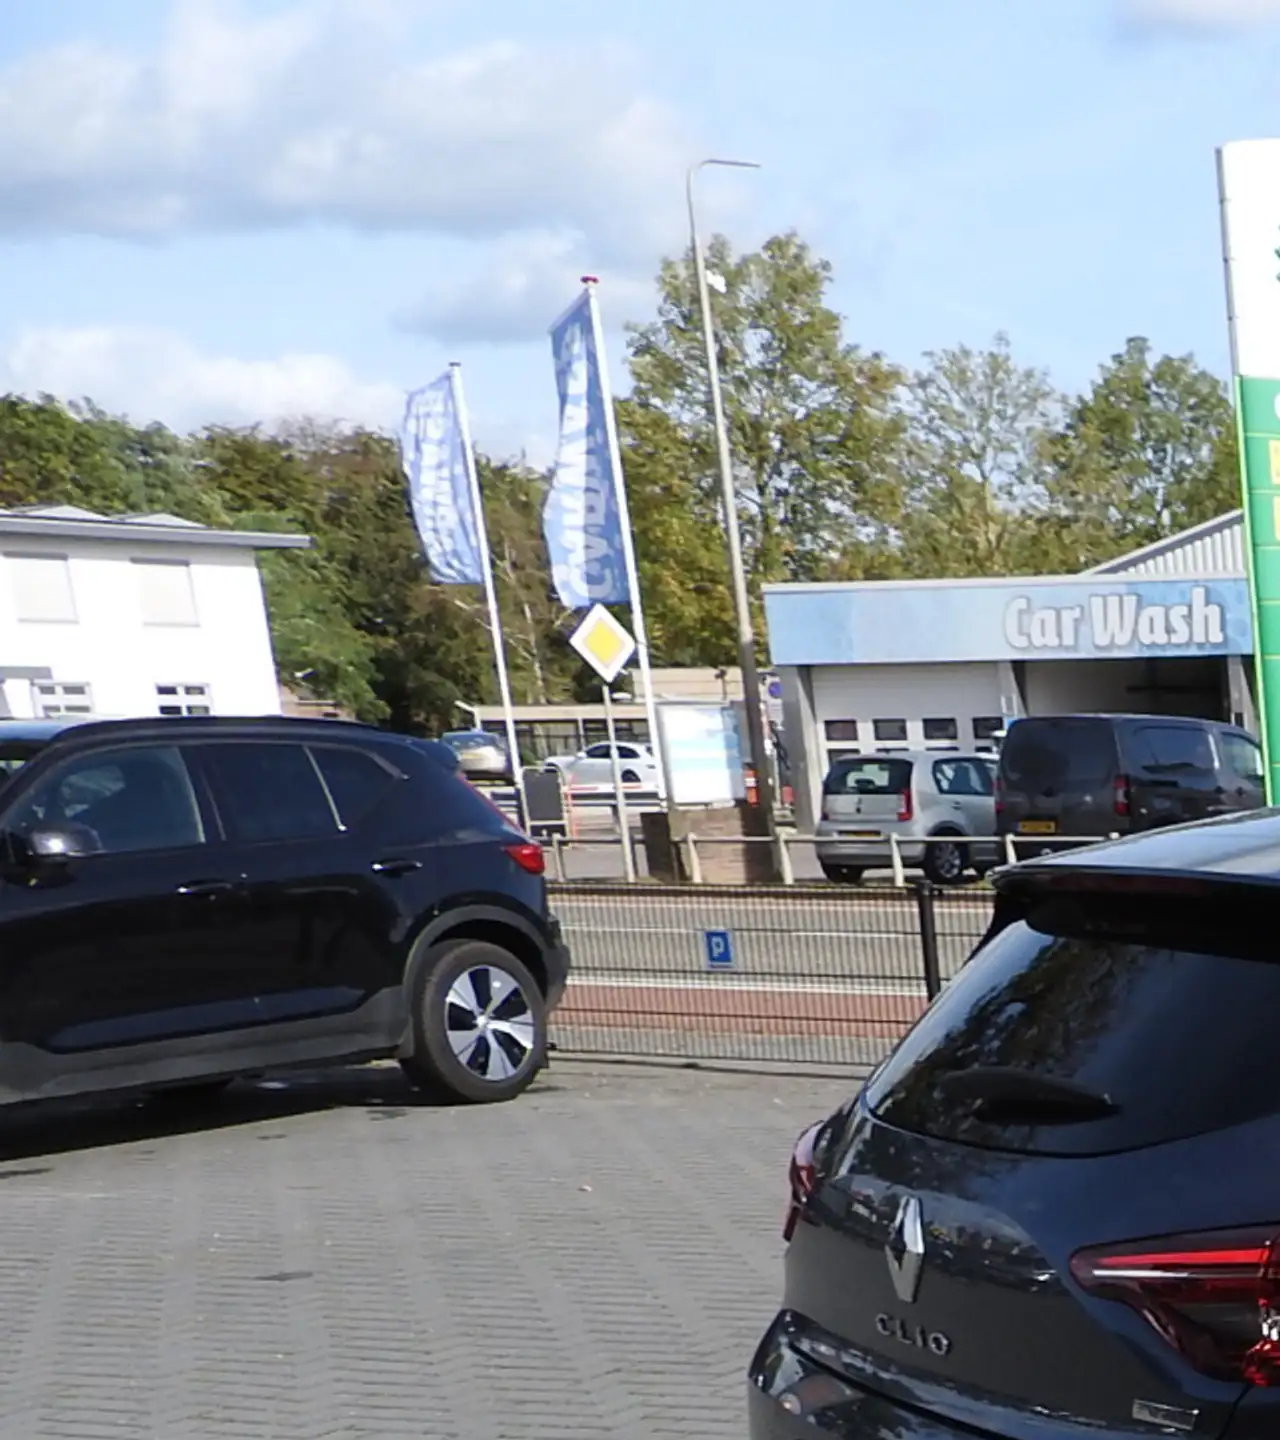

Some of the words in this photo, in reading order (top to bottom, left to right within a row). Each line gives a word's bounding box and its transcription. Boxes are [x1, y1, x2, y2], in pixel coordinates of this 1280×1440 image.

[1004, 595, 1083, 649] Car
[1088, 585, 1225, 648] Wash
[875, 1312, 950, 1356] CLIO
